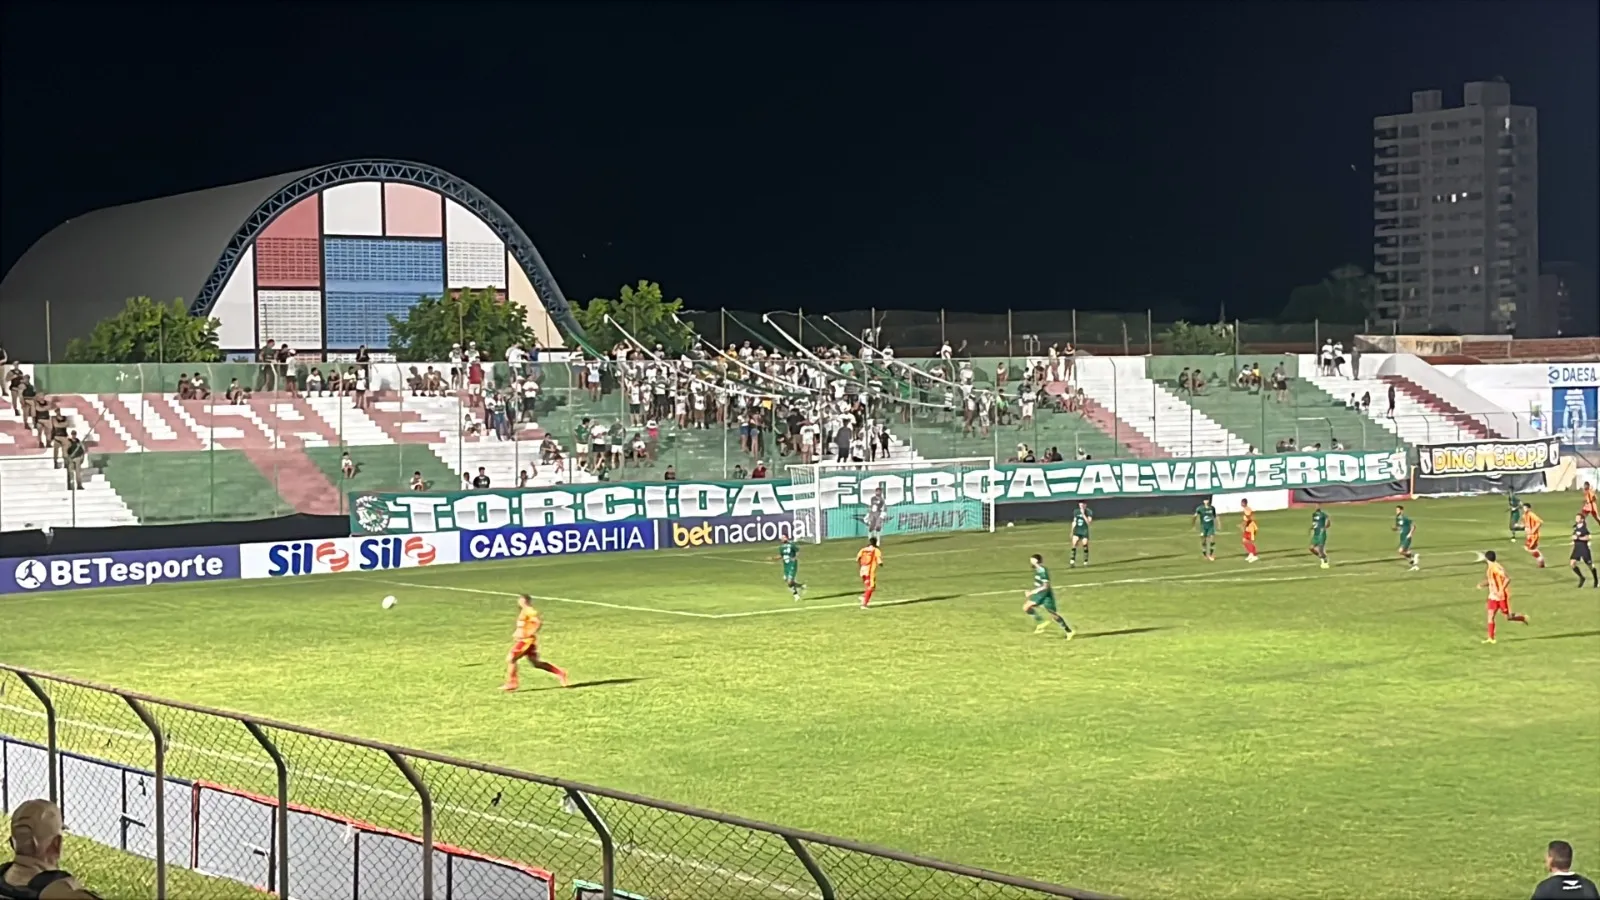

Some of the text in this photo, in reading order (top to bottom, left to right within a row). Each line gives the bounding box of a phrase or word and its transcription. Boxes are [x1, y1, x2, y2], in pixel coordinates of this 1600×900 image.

[1562, 367, 1597, 383] DAESA
[1431, 442, 1549, 475] DINO CHOPP
[396, 484, 783, 533] TORCIDA
[1079, 453, 1391, 495] ALVIVERDE
[673, 513, 813, 548] betnacional
[897, 509, 970, 531] PENALTY
[51, 554, 224, 586] BETesporte
[268, 538, 402, 576] Sil Sil
